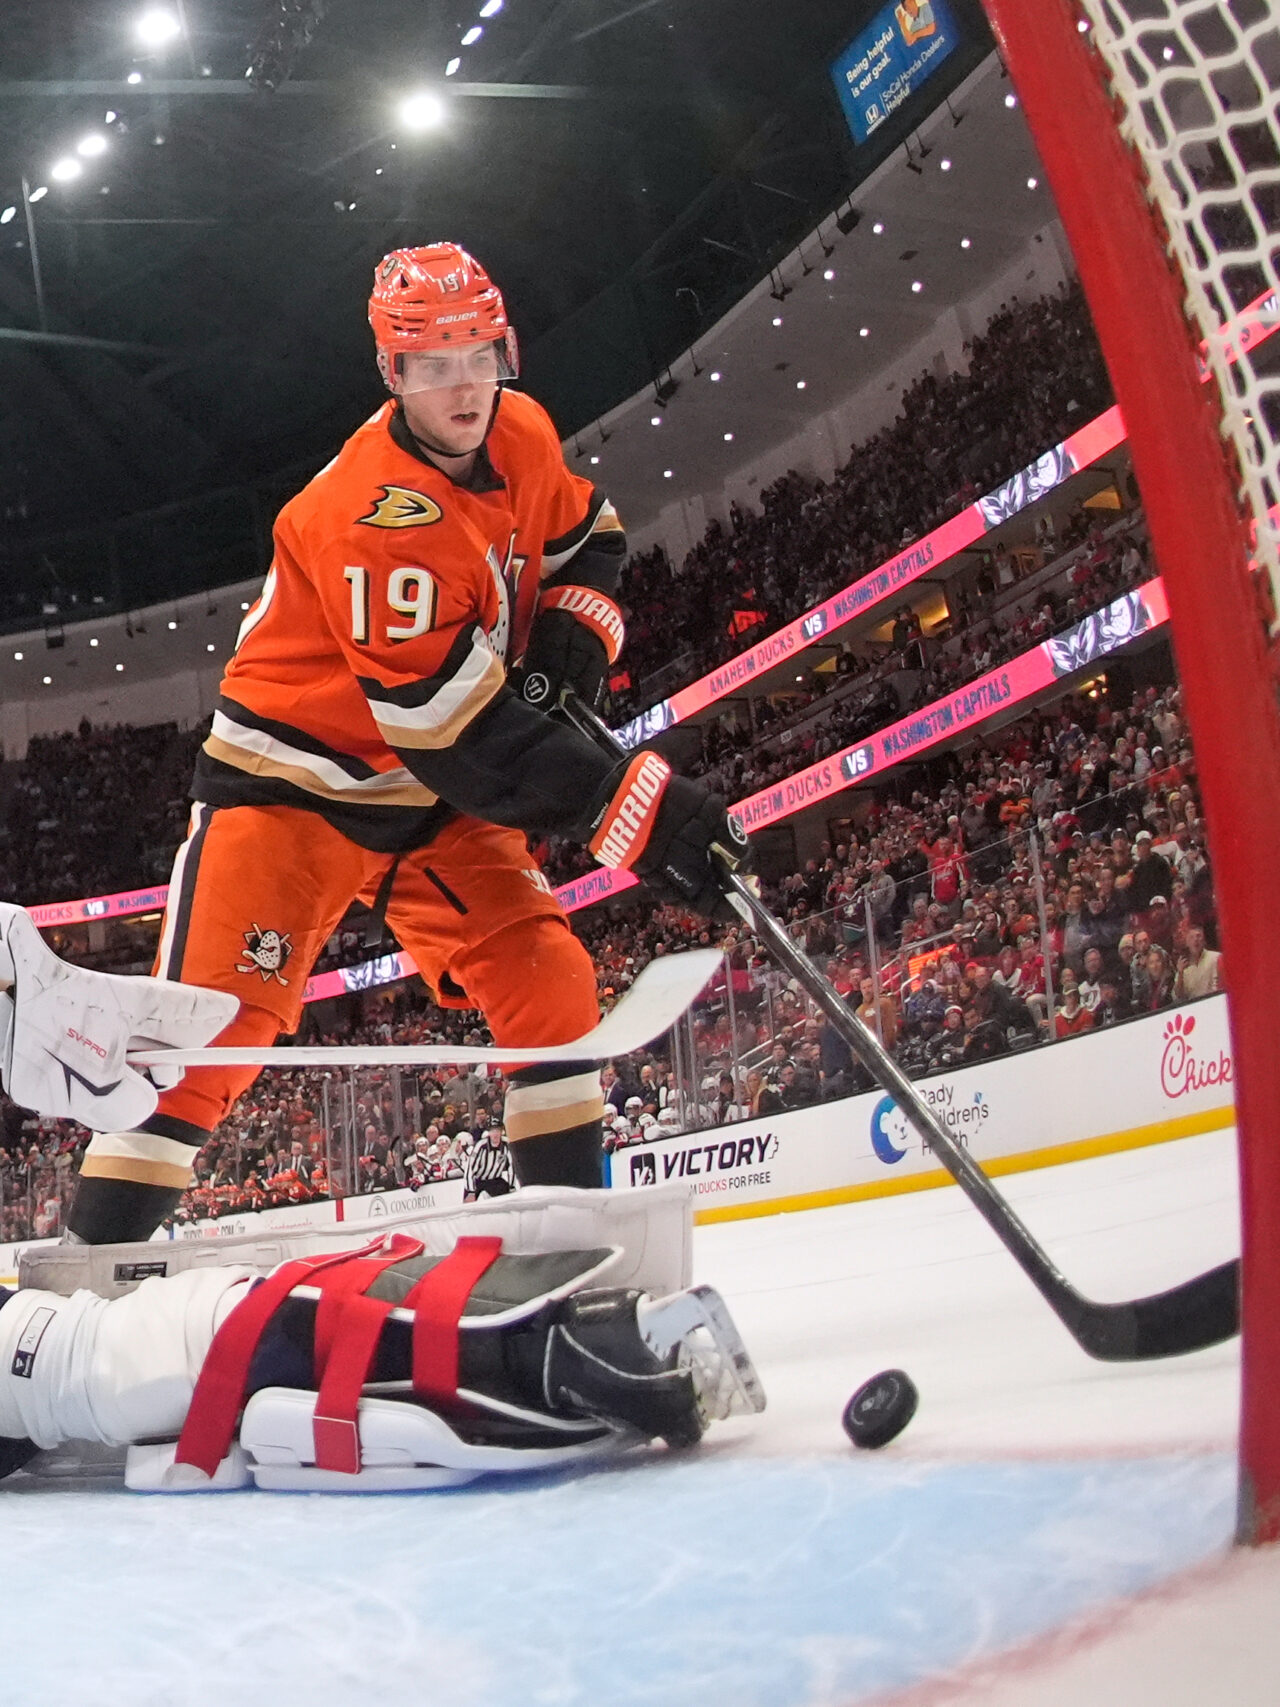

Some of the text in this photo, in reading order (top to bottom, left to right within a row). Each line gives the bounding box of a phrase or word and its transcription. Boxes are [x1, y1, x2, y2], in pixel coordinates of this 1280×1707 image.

[846, 27, 894, 83] Being helpful
[851, 53, 891, 98] is our goal.
[882, 35, 945, 101] SoCal Honda Dealers
[886, 85, 910, 113] Helpful
[435, 310, 478, 325] BAUER
[343, 566, 438, 646] 19
[709, 542, 934, 696] ANAHEIM DUCKS VS WASHINGTON CAPITALS
[734, 674, 1011, 829] NAHEIM DUCKS VS WASHINGTON CAPITALS
[594, 755, 670, 870] WARRIOR
[577, 872, 613, 901] CAPITALS
[31, 906, 73, 923] DUCKS
[939, 1103, 989, 1127] ildrens
[663, 1133, 773, 1180] VICTORY
[391, 1196, 435, 1214] CONCORDIA
[699, 1178, 727, 1195] DUCKS
[729, 1174, 747, 1189] FOR
[748, 1170, 771, 1187] FREE
